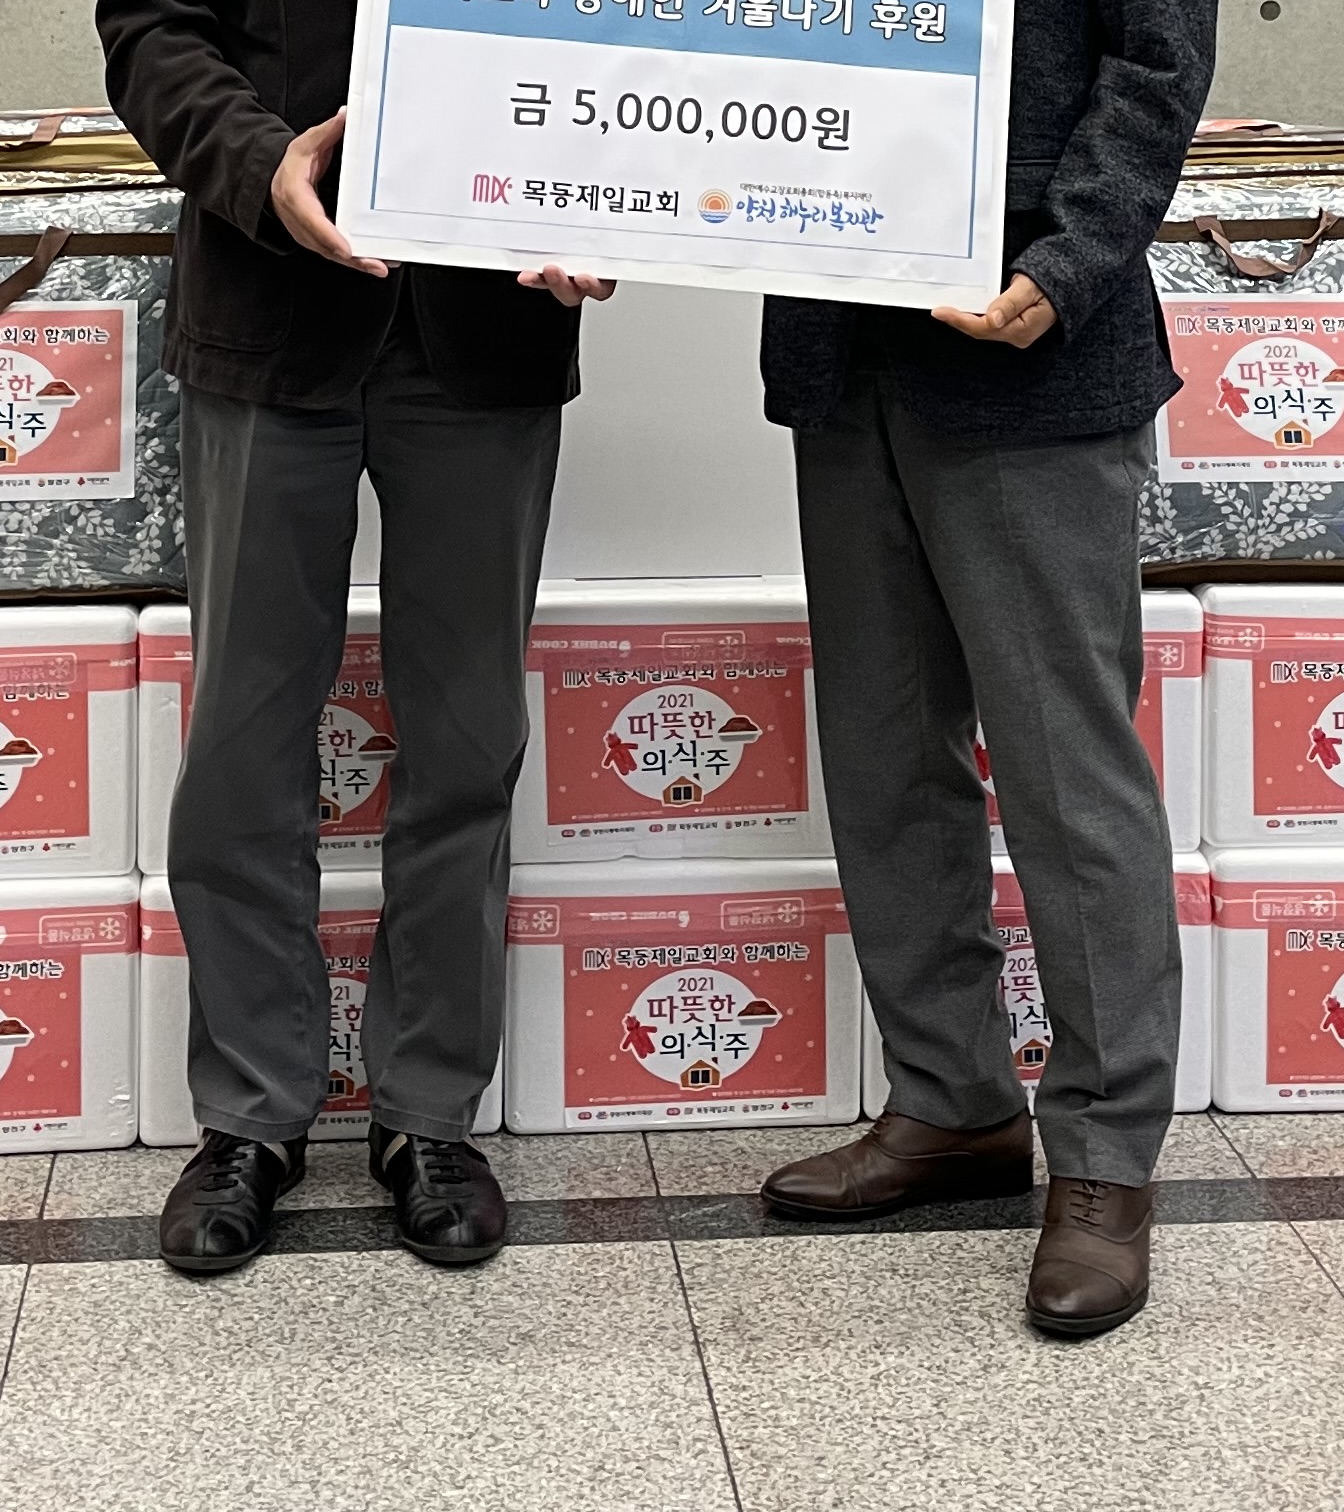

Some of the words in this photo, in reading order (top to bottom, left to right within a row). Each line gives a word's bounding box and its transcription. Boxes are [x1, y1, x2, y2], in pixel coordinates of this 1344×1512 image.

[509, 82, 553, 128] 금
[571, 87, 852, 151] 5,000,000원
[521, 179, 681, 218] 목동제일교회
[736, 194, 776, 224] 양천
[779, 196, 827, 234] 해누리
[829, 200, 885, 234] 복지관
[44, 328, 108, 344] 함께하는
[1205, 317, 1316, 335] 목동제일교회와
[1263, 345, 1299, 360] 2021
[1238, 362, 1320, 388] 따뜻한
[1253, 389, 1336, 422] 의·식·주
[657, 693, 695, 709] 2021
[627, 710, 716, 742] 따뜻한
[641, 740, 731, 776] 의·식·주
[616, 945, 738, 967] 목동제일교회와
[743, 943, 809, 962] 함께하는
[1007, 957, 1036, 973] 202
[677, 976, 715, 992] 2021
[647, 994, 737, 1025] 따뜻한
[659, 1024, 750, 1059] 의·식·주
